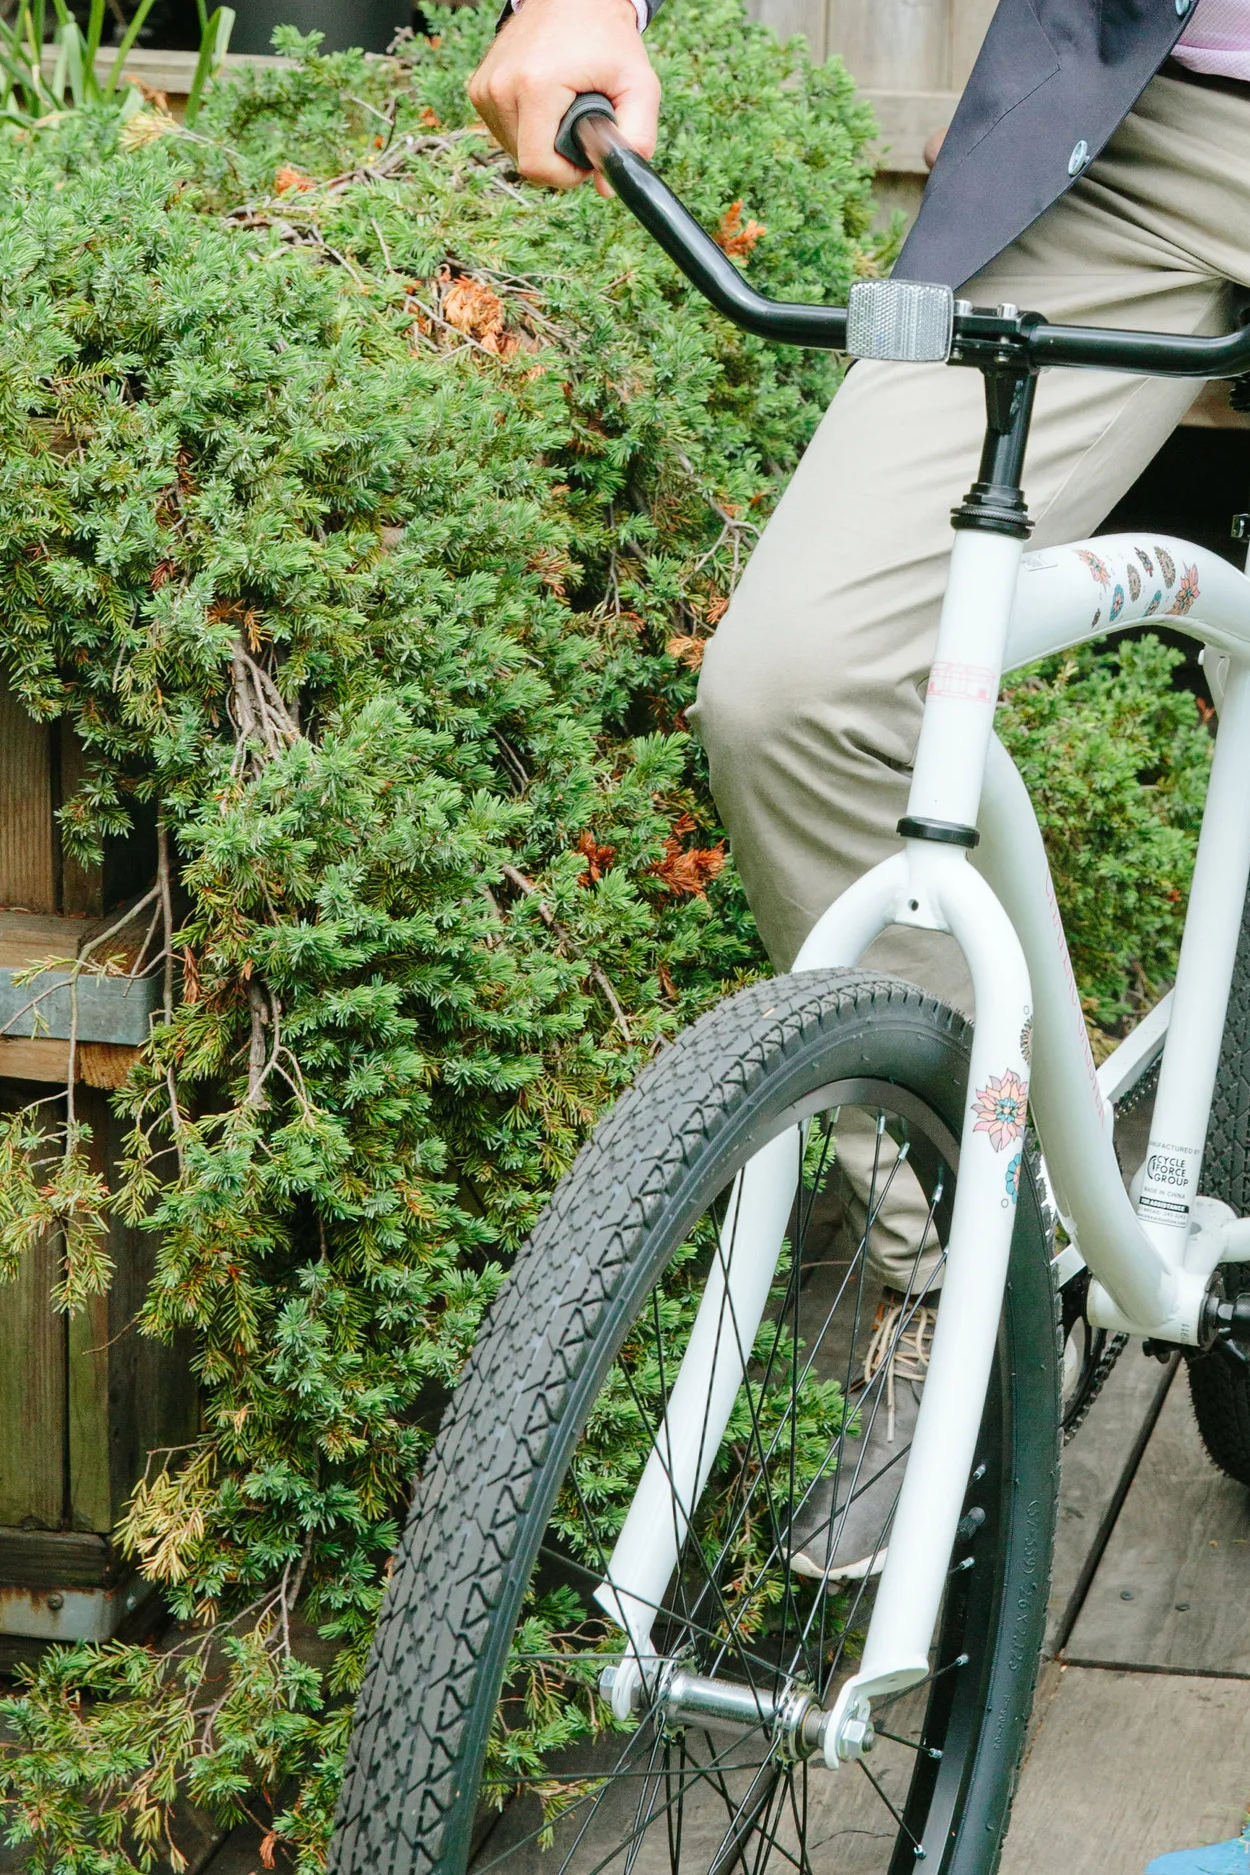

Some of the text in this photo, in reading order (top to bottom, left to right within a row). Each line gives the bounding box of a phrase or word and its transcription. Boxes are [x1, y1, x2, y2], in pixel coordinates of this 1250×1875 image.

[1157, 1155, 1186, 1168] CYCLE
[1156, 1164, 1187, 1178] FORCE
[1154, 1173, 1189, 1187] GROUP
